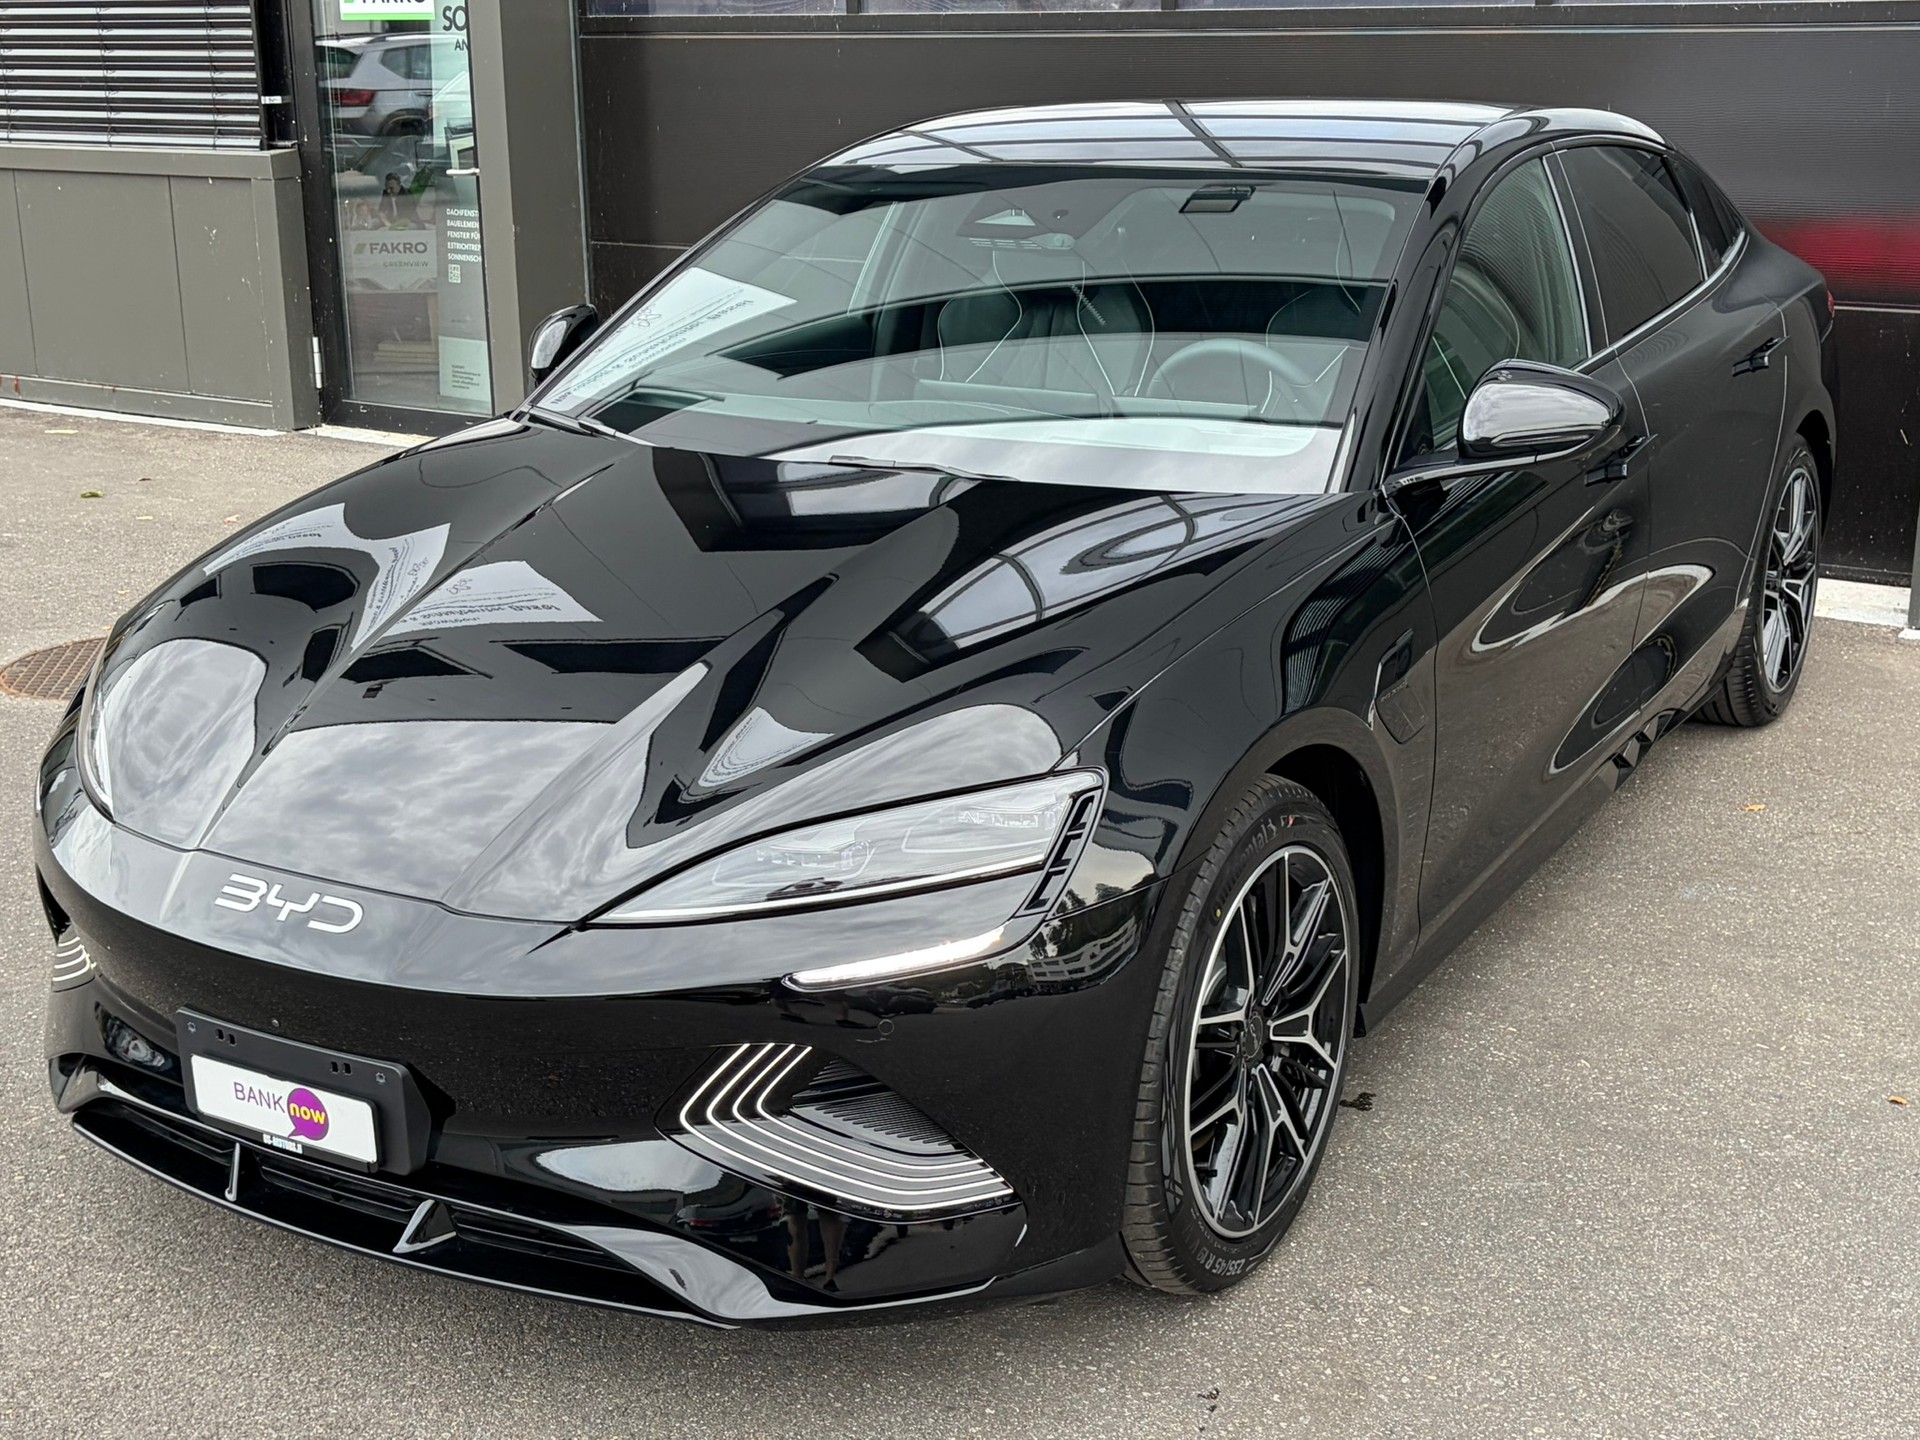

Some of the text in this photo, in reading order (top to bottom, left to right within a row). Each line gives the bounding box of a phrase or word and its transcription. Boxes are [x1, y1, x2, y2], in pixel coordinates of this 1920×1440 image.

[447, 230, 470, 239] FENSTER
[369, 242, 428, 254] FAKRO
[214, 872, 364, 934] BYD
[233, 1081, 326, 1125] BANK now
[1212, 1258, 1246, 1276] 235/45
